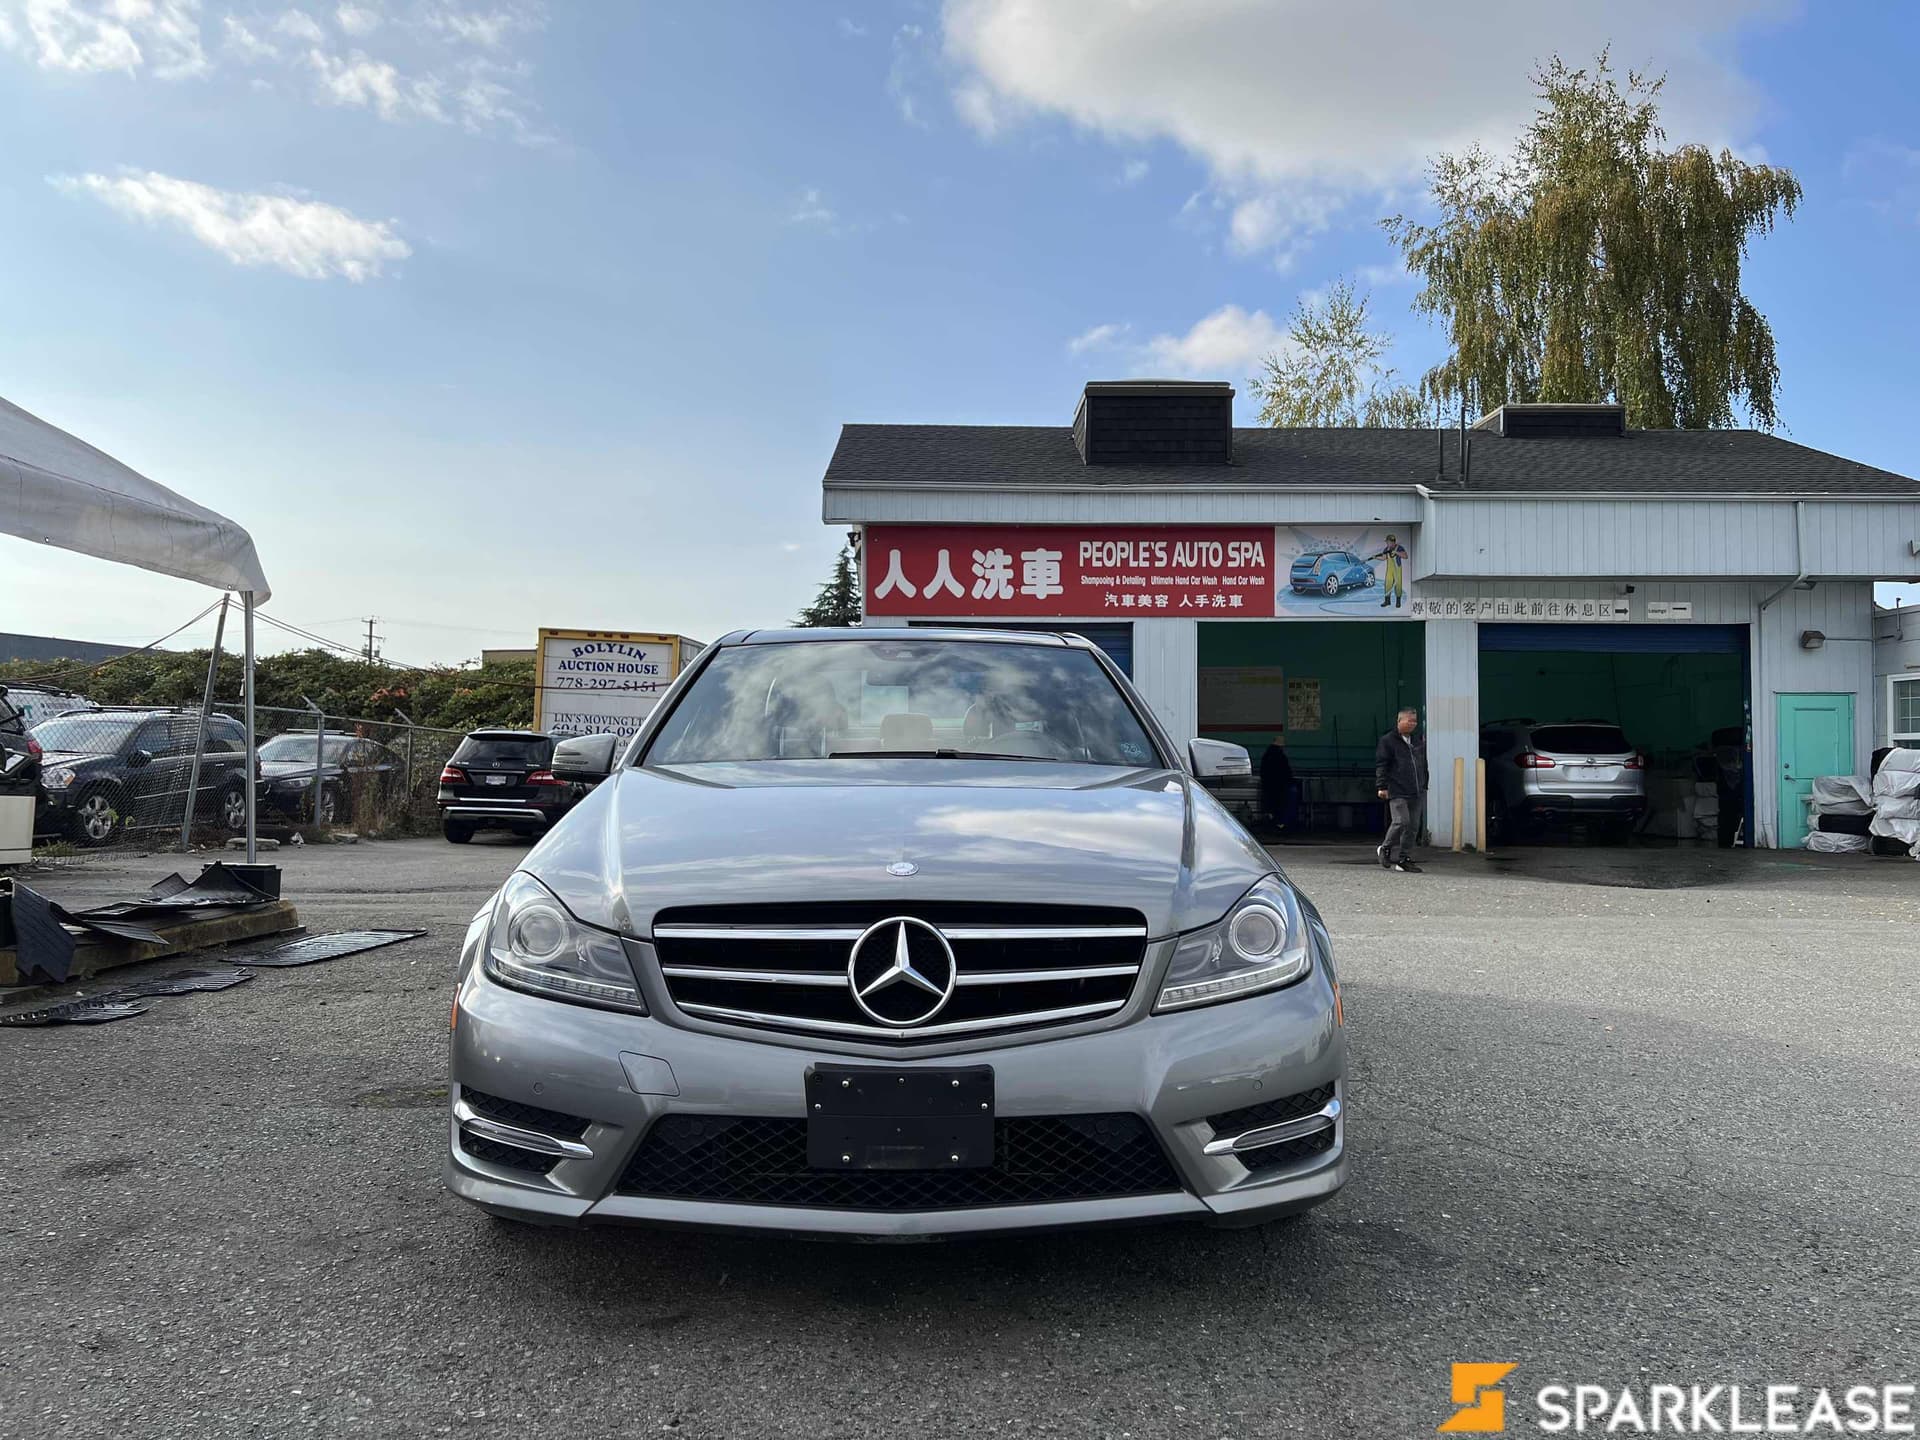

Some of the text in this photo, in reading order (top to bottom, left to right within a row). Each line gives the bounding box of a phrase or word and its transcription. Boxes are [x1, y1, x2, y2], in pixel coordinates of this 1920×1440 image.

[1079, 541, 1265, 568] PEOPLE'S AUTO SPA
[874, 548, 1063, 600] 人人洗車
[1080, 575, 1265, 587] Shampooing & Detailing Ultimate Hand Car Wash Hand Car Wash
[1104, 591, 1243, 608] 汽車美容 人手洗車
[572, 642, 647, 662] BOLYLIN
[558, 660, 659, 675] AUCTION HOUSE
[557, 676, 657, 693] 778-297-5151
[582, 714, 628, 727] MOVING
